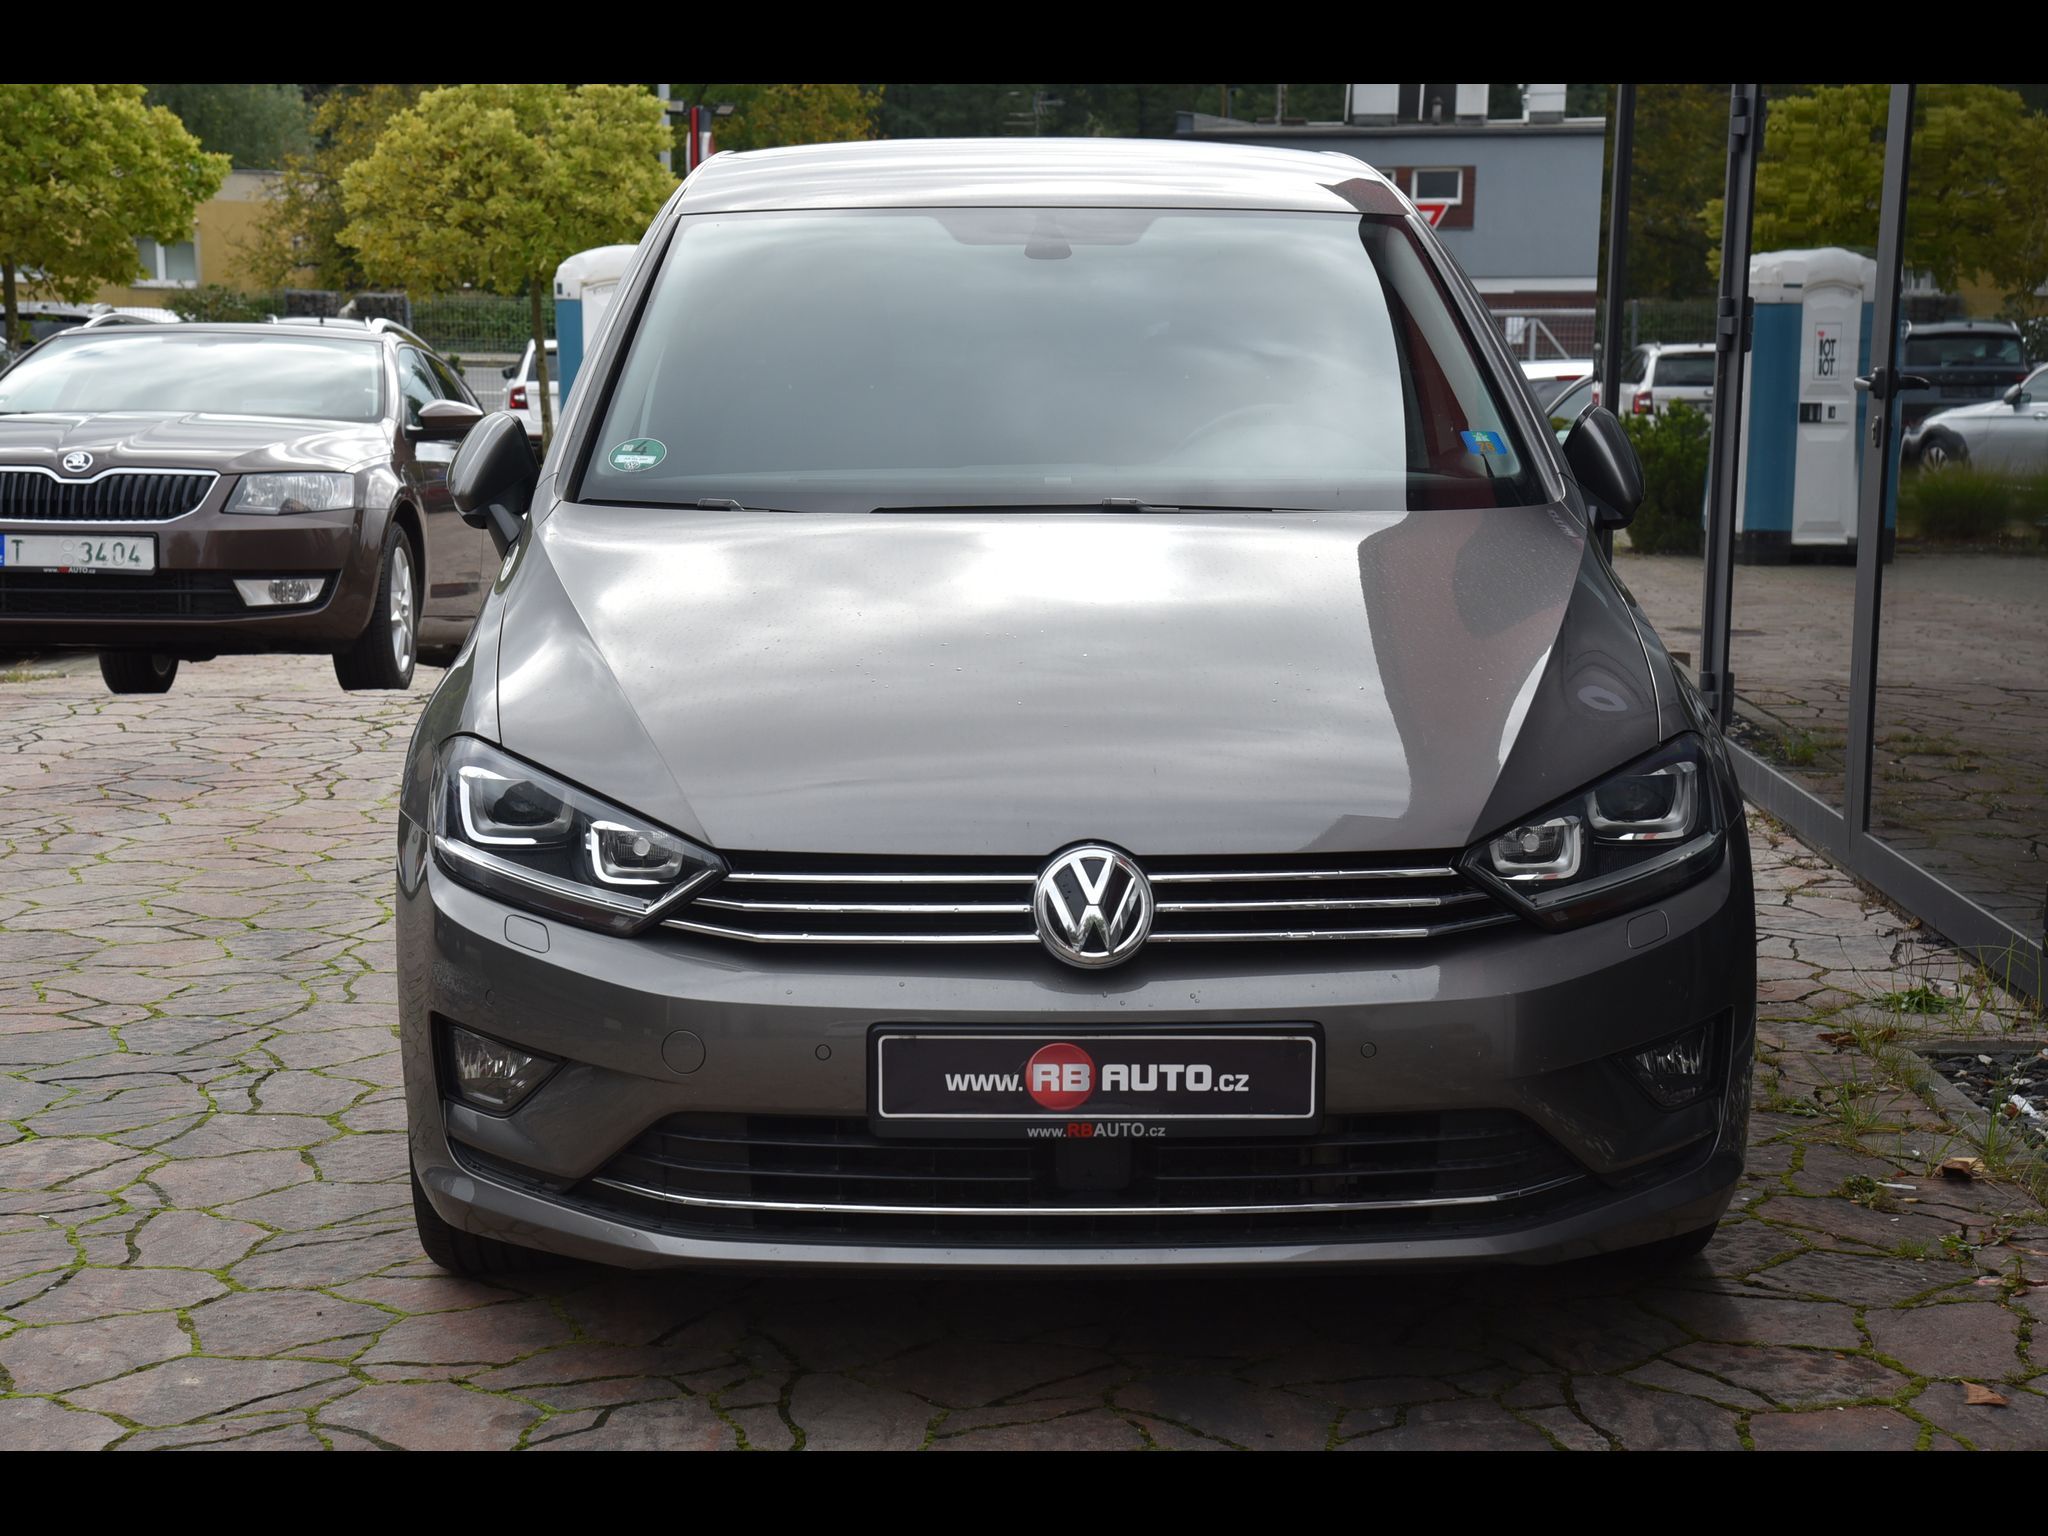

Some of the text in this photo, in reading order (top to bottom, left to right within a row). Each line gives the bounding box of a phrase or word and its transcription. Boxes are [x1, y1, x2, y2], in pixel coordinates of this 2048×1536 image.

[11, 539, 141, 565] T 3404
[1026, 1122, 1166, 1138] www.RBAUTO.cz
